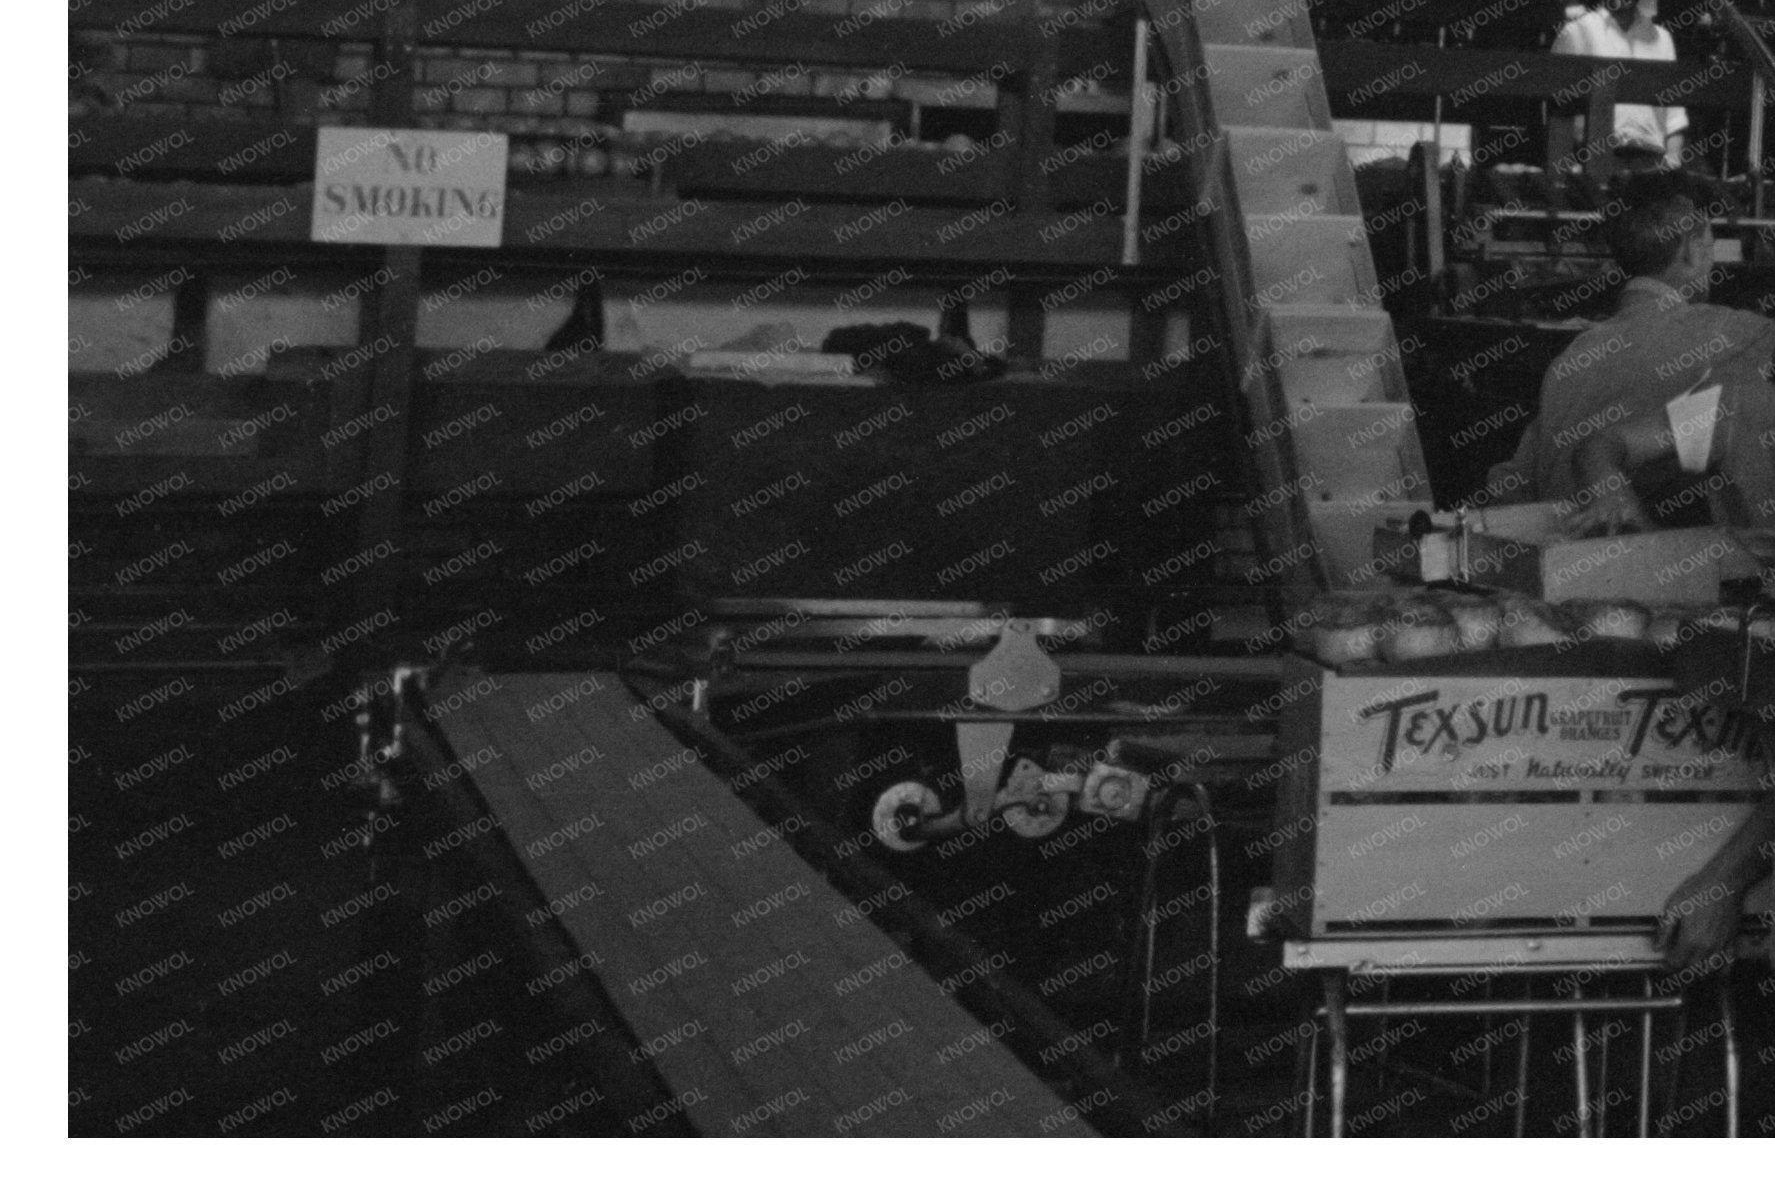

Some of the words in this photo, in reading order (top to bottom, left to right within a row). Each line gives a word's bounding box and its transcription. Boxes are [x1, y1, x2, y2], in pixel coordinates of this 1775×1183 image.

[388, 142, 437, 174] NO
[325, 184, 498, 218] SMOKING
[1550, 710, 1632, 727] GRAPEFRUIT
[1559, 727, 1621, 741] ORANGES
[1469, 763, 1511, 780] JUST
[1526, 757, 1633, 785] Naturally
